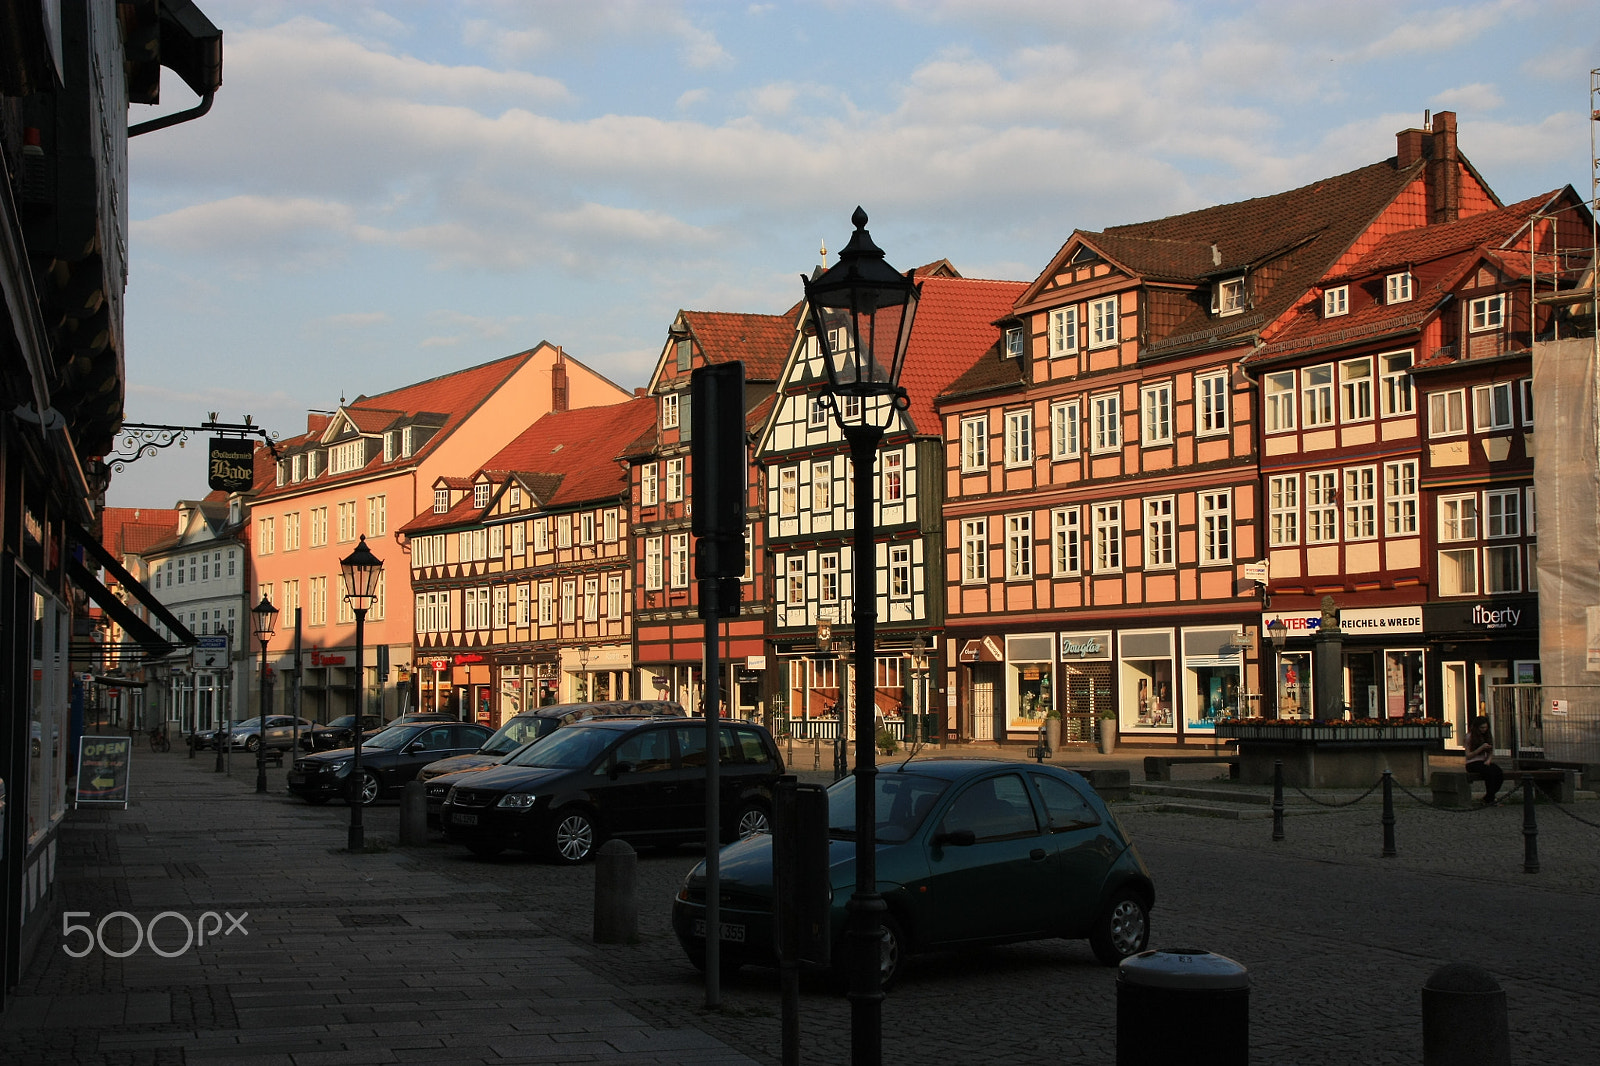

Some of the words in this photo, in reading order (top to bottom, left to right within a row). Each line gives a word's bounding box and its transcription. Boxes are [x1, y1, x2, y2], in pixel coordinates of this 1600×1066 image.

[210, 459, 252, 480] Bade
[1341, 619, 1378, 629] REICHEL
[1379, 618, 1386, 627] &
[1388, 617, 1420, 627] WREDE
[1472, 604, 1520, 626] liberty
[1063, 637, 1101, 658] Douglas
[84, 742, 126, 756] OPEN
